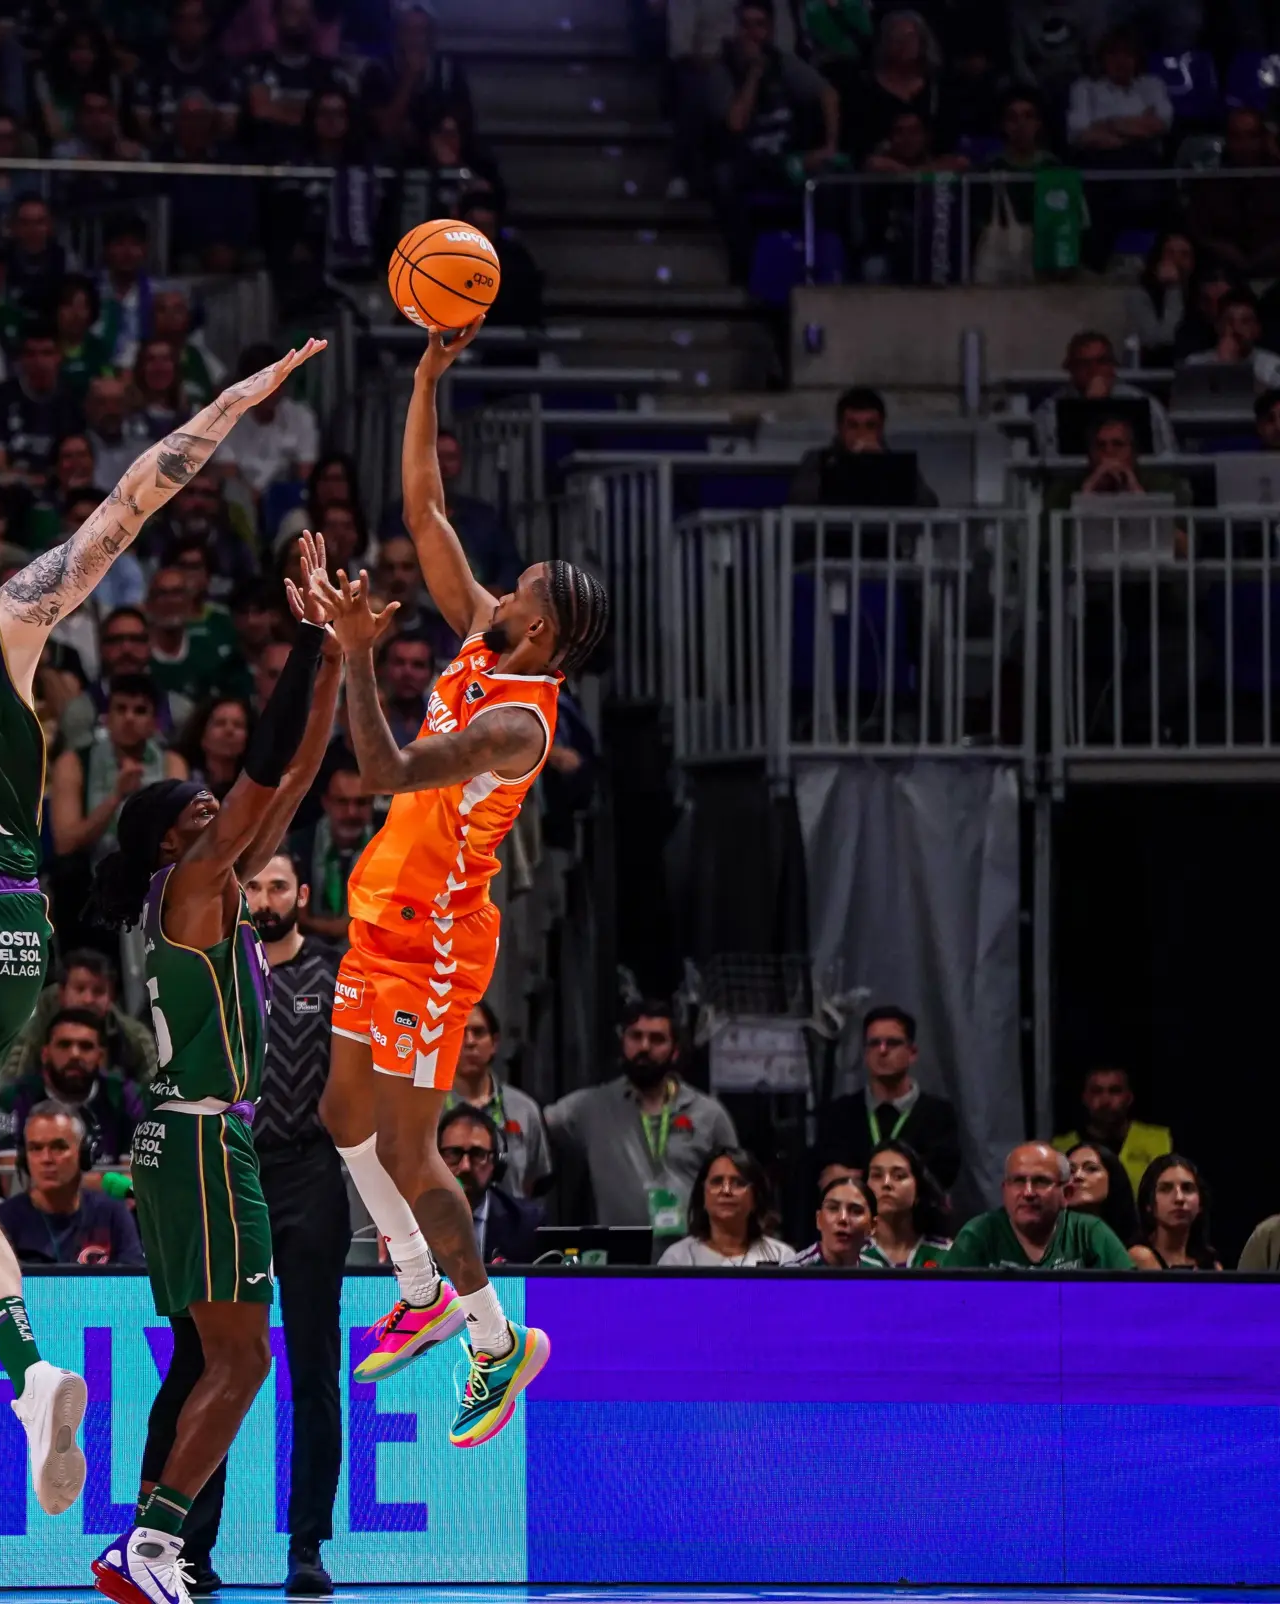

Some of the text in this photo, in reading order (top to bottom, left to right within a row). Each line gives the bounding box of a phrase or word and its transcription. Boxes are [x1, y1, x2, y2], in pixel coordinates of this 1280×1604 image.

[473, 272, 494, 288] acb
[20, 949, 41, 963] SOL
[396, 1016, 412, 1026] acb
[141, 1139, 163, 1155] SOL
[9, 1306, 35, 1342] UNICAJA
